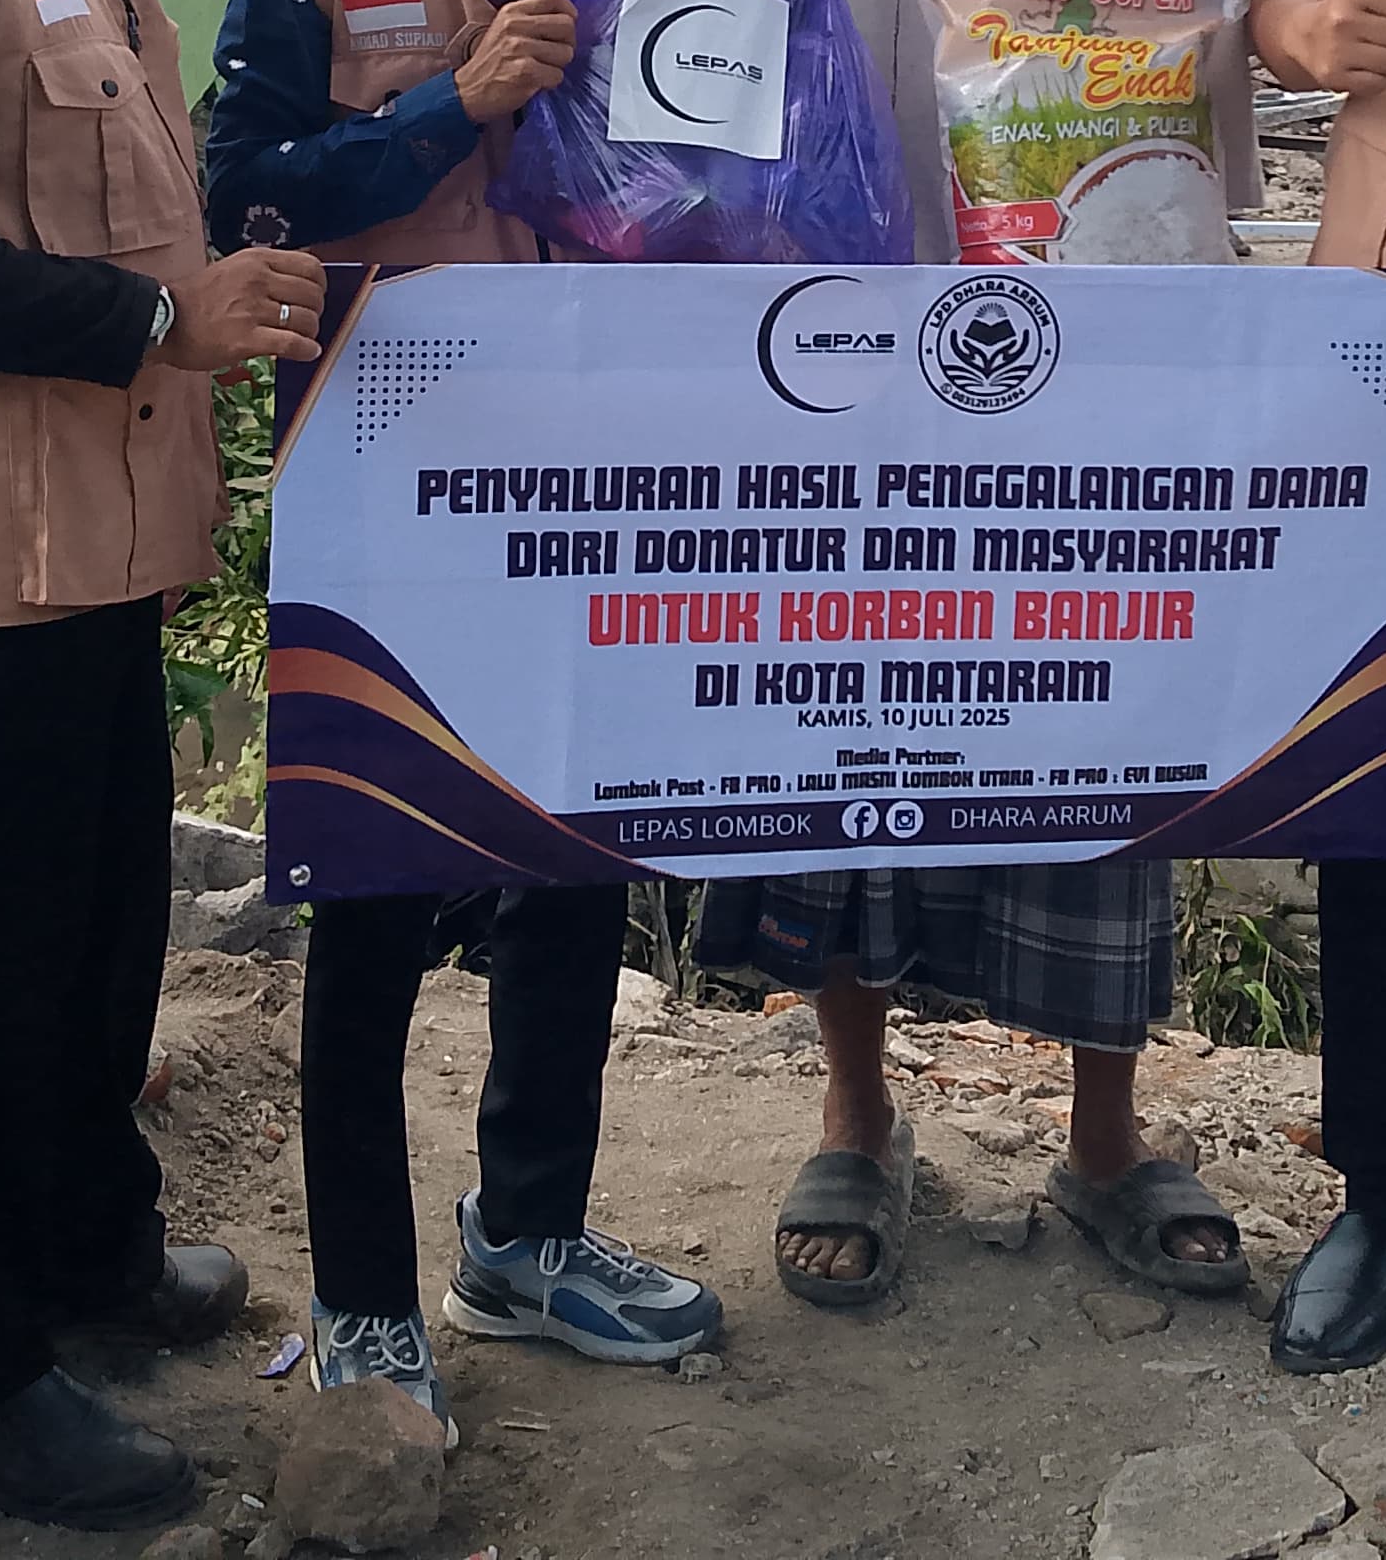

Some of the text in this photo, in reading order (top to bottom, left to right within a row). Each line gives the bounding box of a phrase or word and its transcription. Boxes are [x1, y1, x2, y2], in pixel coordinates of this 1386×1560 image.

[969, 11, 1156, 67] Tanjung
[676, 53, 763, 80] LEPAS
[1083, 49, 1198, 108] Enak
[991, 116, 1197, 144] ENAK, WANGI & PULEN
[1002, 214, 1011, 230] 5
[1016, 213, 1033, 232] kg
[930, 281, 1051, 329] LPD DHARA ARRUM
[796, 333, 895, 348] LEPAS
[417, 464, 1369, 515] PENYALURAN HASIL PENGGALANGAN DANA
[507, 526, 1282, 578] DARI DONATUR DAN MASYARAKAT
[589, 590, 1195, 646] UNTUK KORBAN BANJIR
[695, 659, 1111, 707] DI KOTA MATARAM
[798, 707, 1010, 730] KAMIS, 10 JULI 2025
[836, 747, 965, 767] Media Partner:
[594, 779, 661, 800] Lombok
[666, 778, 705, 797] Post
[720, 776, 741, 794] FB
[745, 775, 781, 793] PRO
[797, 773, 837, 791] LALU
[902, 770, 973, 789] LOMBOK
[1049, 769, 1069, 786] FB
[1074, 767, 1108, 786] PRO
[1123, 766, 1150, 784] EVI
[619, 813, 812, 843] LEPAS LOMBOK
[951, 803, 1132, 829] DHARA ARRUM
